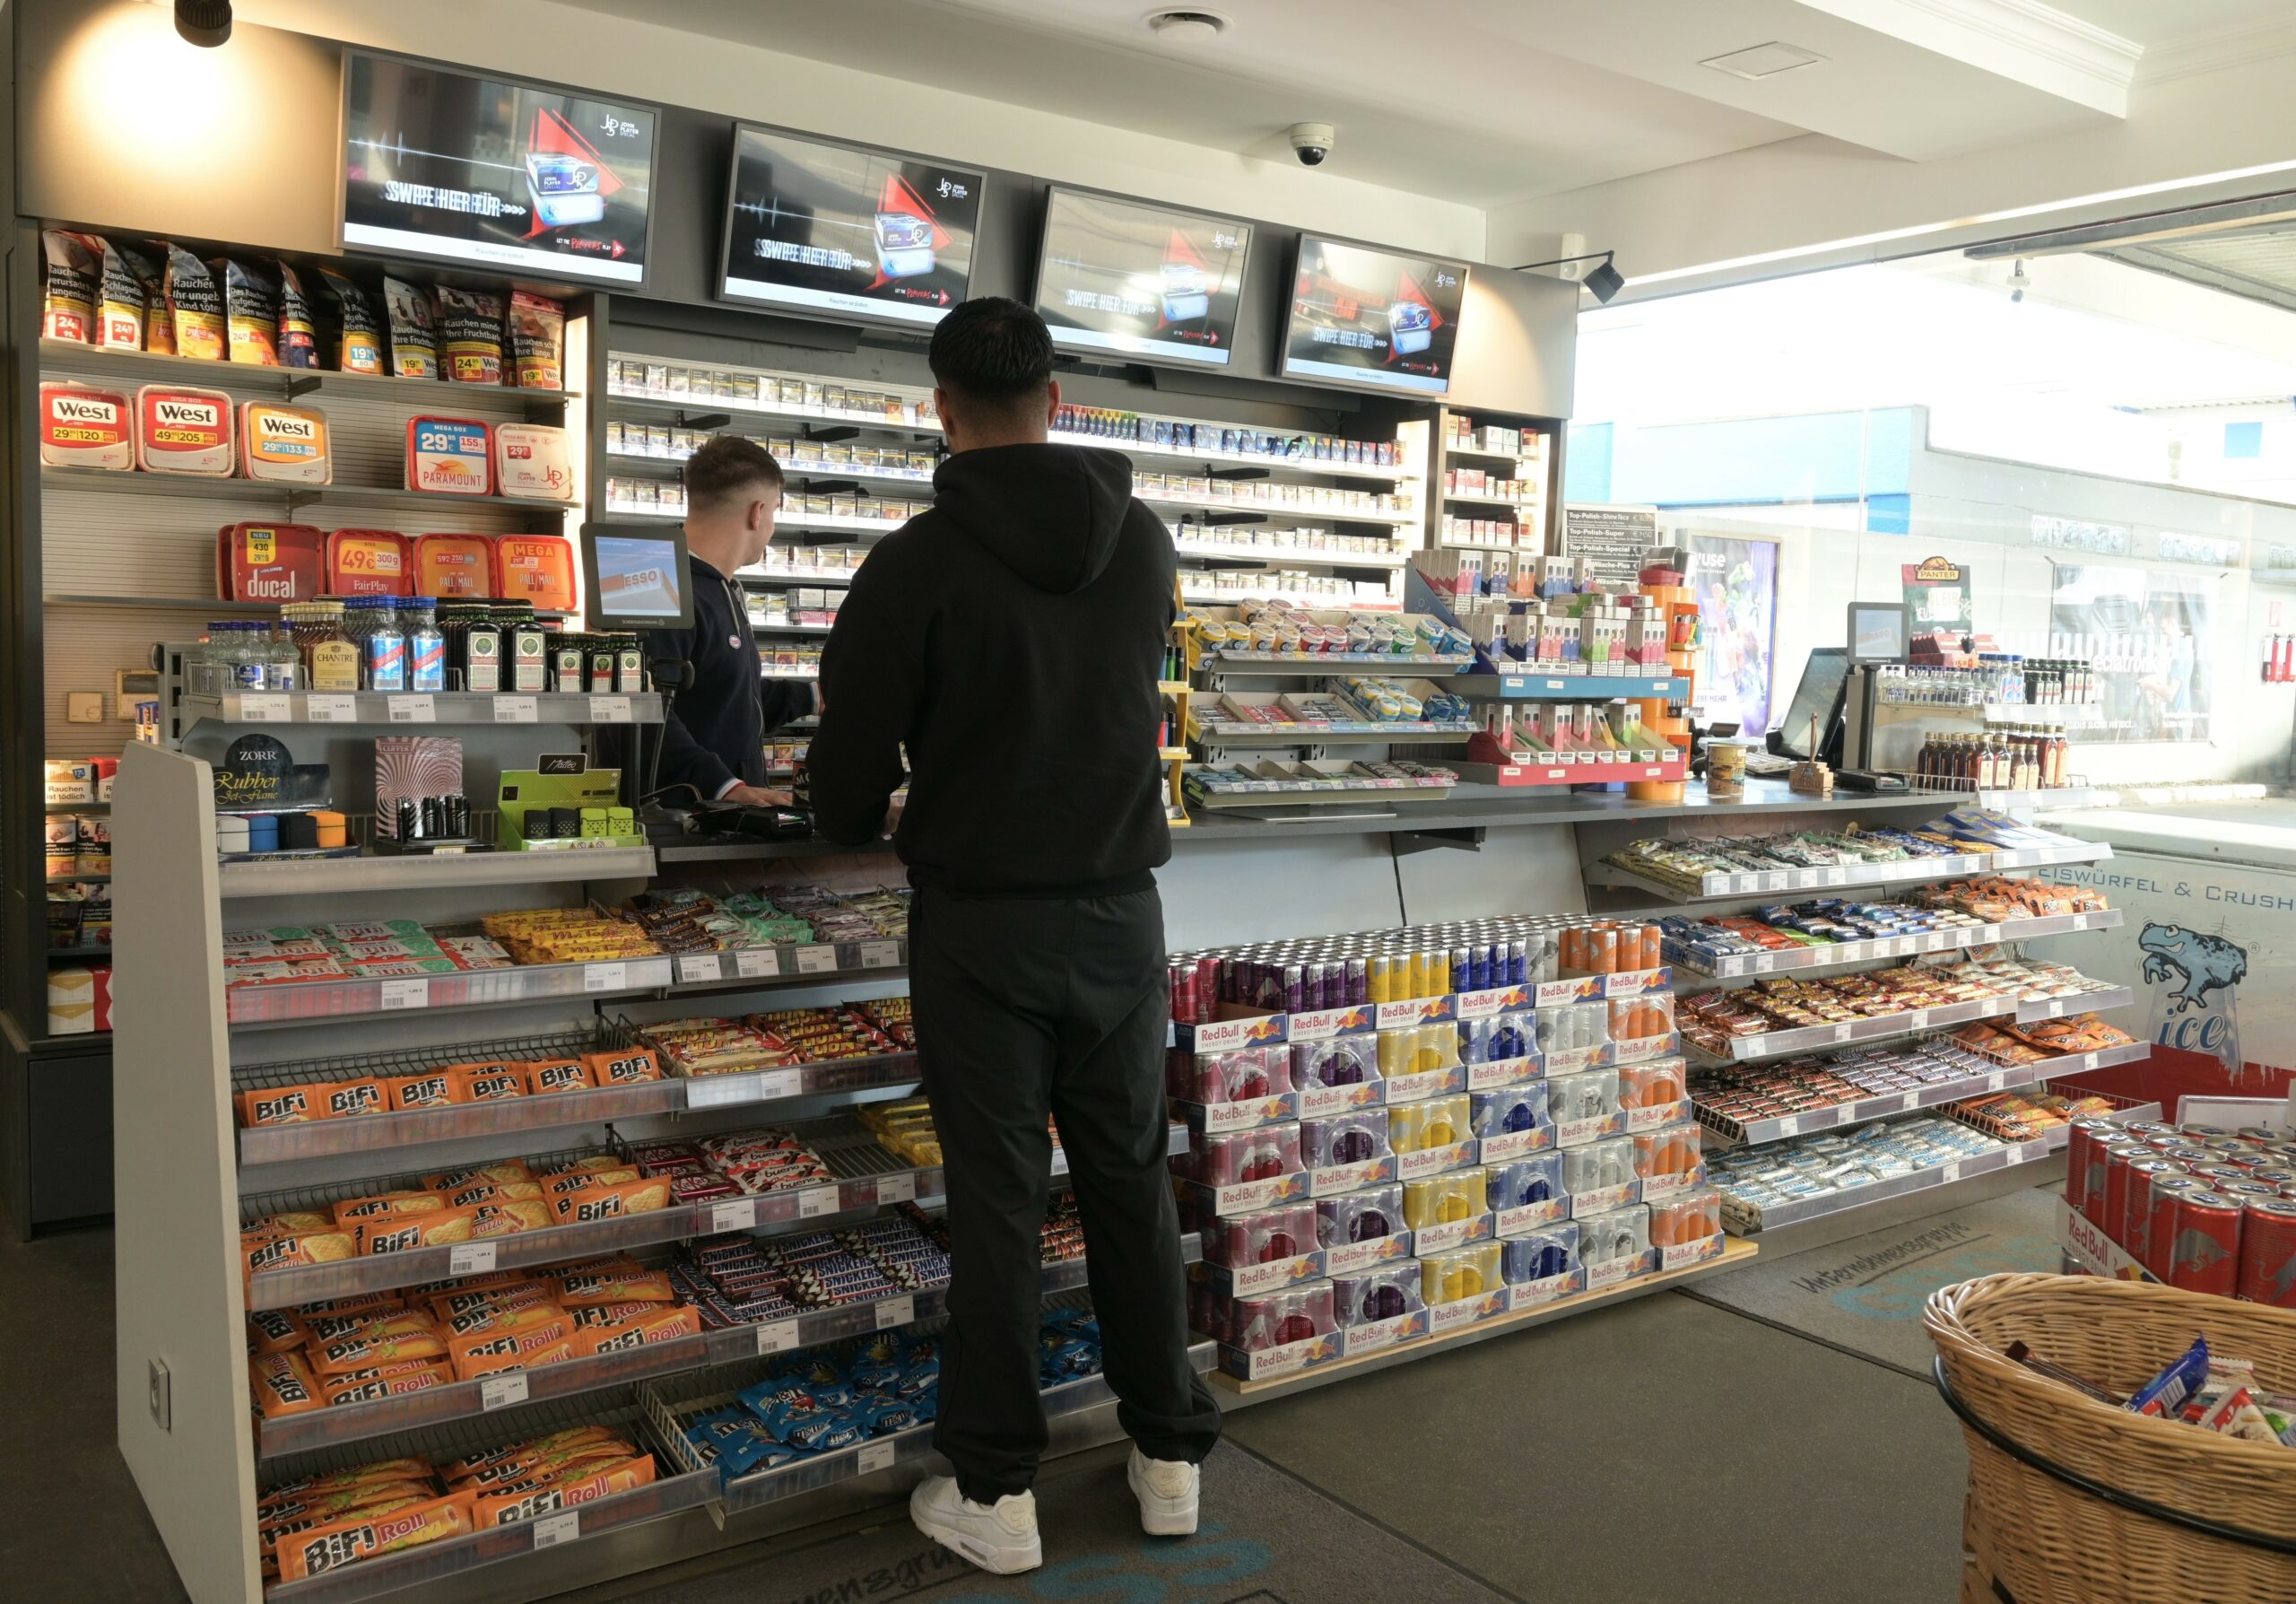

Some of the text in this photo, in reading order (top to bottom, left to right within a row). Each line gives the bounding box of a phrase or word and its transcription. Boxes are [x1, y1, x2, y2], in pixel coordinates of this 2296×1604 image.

[620, 120, 635, 128] JOHN
[620, 126, 639, 135] PLAYER
[174, 278, 214, 289] Rauchen
[173, 289, 187, 300] Ihr
[245, 288, 266, 301] Rauchen
[1066, 289, 1096, 309] SWIPE
[1099, 294, 1120, 311] HIER
[176, 300, 198, 311] Kind
[446, 318, 479, 329] Rauchen
[447, 329, 463, 338] Ihre
[1313, 326, 1374, 350] SWIPE HIER FÜR
[532, 348, 552, 359] Lunge
[57, 401, 112, 421] West
[161, 404, 213, 423] West
[264, 418, 309, 437] West
[461, 437, 478, 448] 155
[423, 471, 482, 487] PARAMOUNT
[253, 543, 269, 552] 430
[514, 545, 554, 557] MEGA
[247, 569, 295, 598] ducal
[439, 576, 474, 588] PALL MALL
[518, 573, 555, 586] PALL MALL
[624, 571, 657, 588] ESSO
[1919, 571, 1957, 579] PANTER
[353, 580, 388, 592] FairPlay
[239, 751, 278, 761] ZORR
[48, 784, 83, 793] Rauchen
[213, 771, 280, 791] Rubber
[46, 792, 85, 801] ist tödlich
[2039, 867, 2163, 894] EISWÜRFEL
[2174, 882, 2192, 897] &
[664, 900, 697, 915] SNICKERS
[1609, 974, 1639, 989] Red Bull
[1463, 991, 1496, 1008] Red Bull
[1541, 983, 1571, 999] Red Bull
[1381, 1002, 1415, 1018] Red Bull
[1294, 1013, 1331, 1031] Red Bull
[2157, 1007, 2228, 1051] ice
[1202, 1024, 1240, 1041] Red Bull
[1294, 1030, 1313, 1038] ENERGY
[813, 1042, 855, 1056] LION
[1202, 1037, 1239, 1049] ENERGY DRINK
[539, 1063, 585, 1091] BiFi
[606, 1055, 653, 1083] BiFi
[400, 1076, 448, 1104] BiFi
[471, 1073, 517, 1100] BiFi
[255, 1092, 306, 1123] BiFi
[329, 1084, 379, 1115] BiFi
[1304, 1090, 1341, 1108] Red Bull
[1213, 1104, 1251, 1121] Red Bull
[764, 1164, 800, 1178] bueno
[781, 1233, 835, 1252] SNICKERS
[2068, 1212, 2109, 1268] Red Bull
[700, 1246, 756, 1266] SNICKERS
[816, 1256, 874, 1280] SNICKERS
[823, 1270, 883, 1288] SNICKERS
[520, 1325, 557, 1352] Roll
[648, 1321, 683, 1347] Roll
[392, 1370, 432, 1395] Roll
[304, 1512, 427, 1577] BiFi Roll
